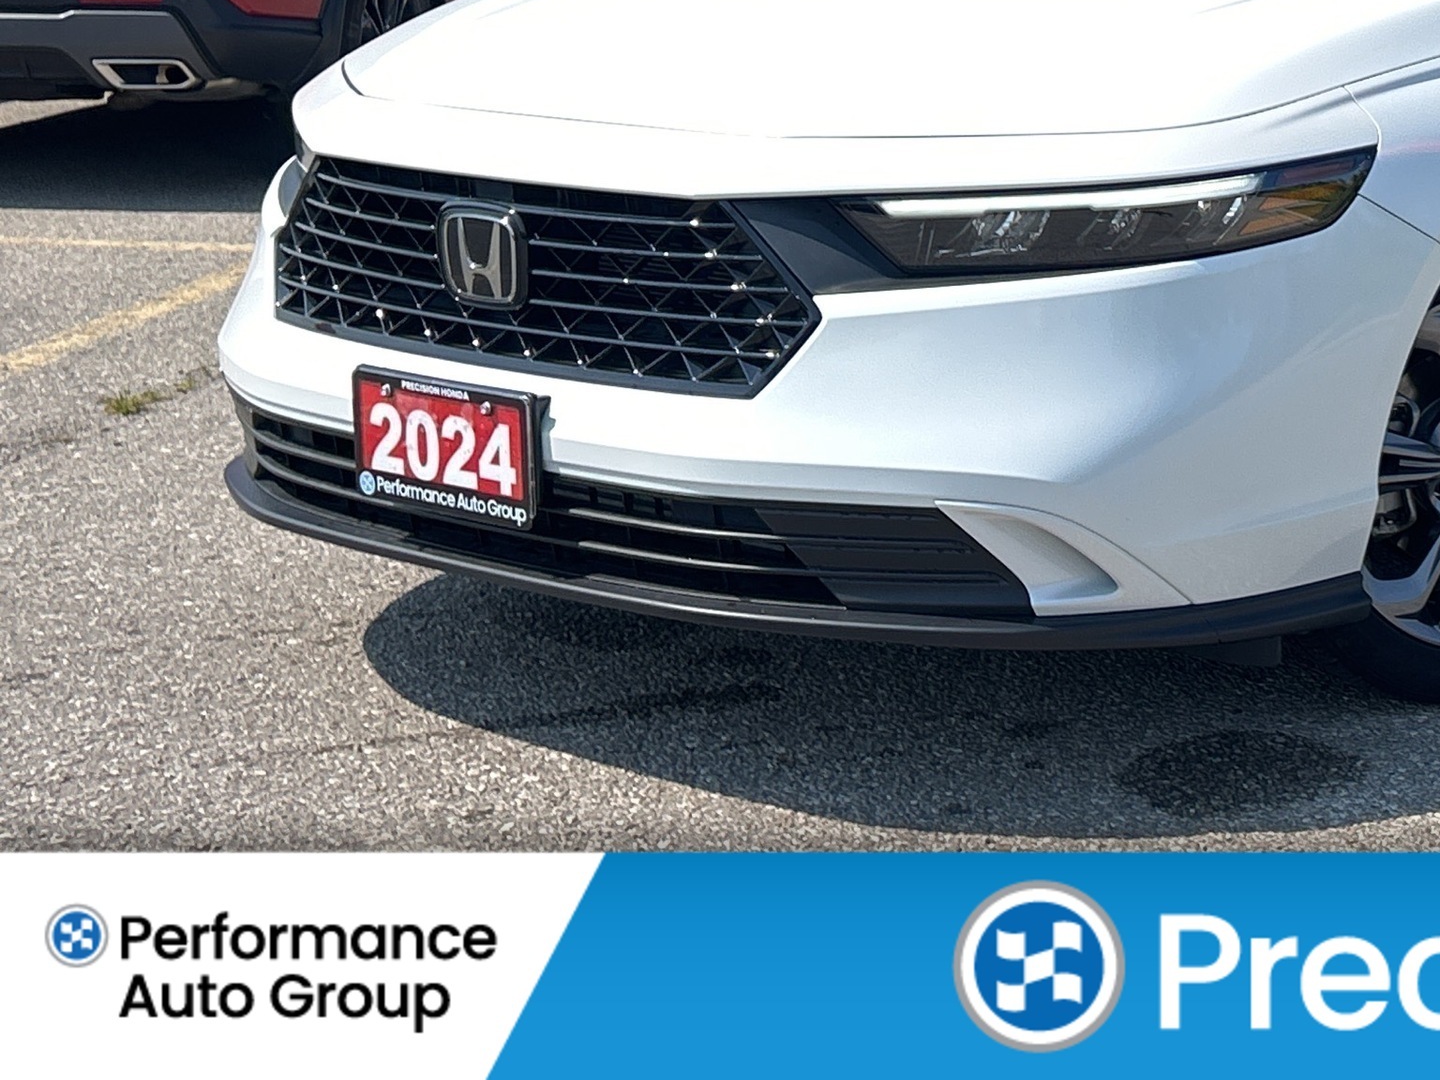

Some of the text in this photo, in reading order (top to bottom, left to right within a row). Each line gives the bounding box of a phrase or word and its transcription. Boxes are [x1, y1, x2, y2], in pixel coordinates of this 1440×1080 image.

[401, 380, 470, 401] PRECISION HONDA
[369, 402, 517, 497] 2024
[376, 476, 527, 527] Performance Auto Group
